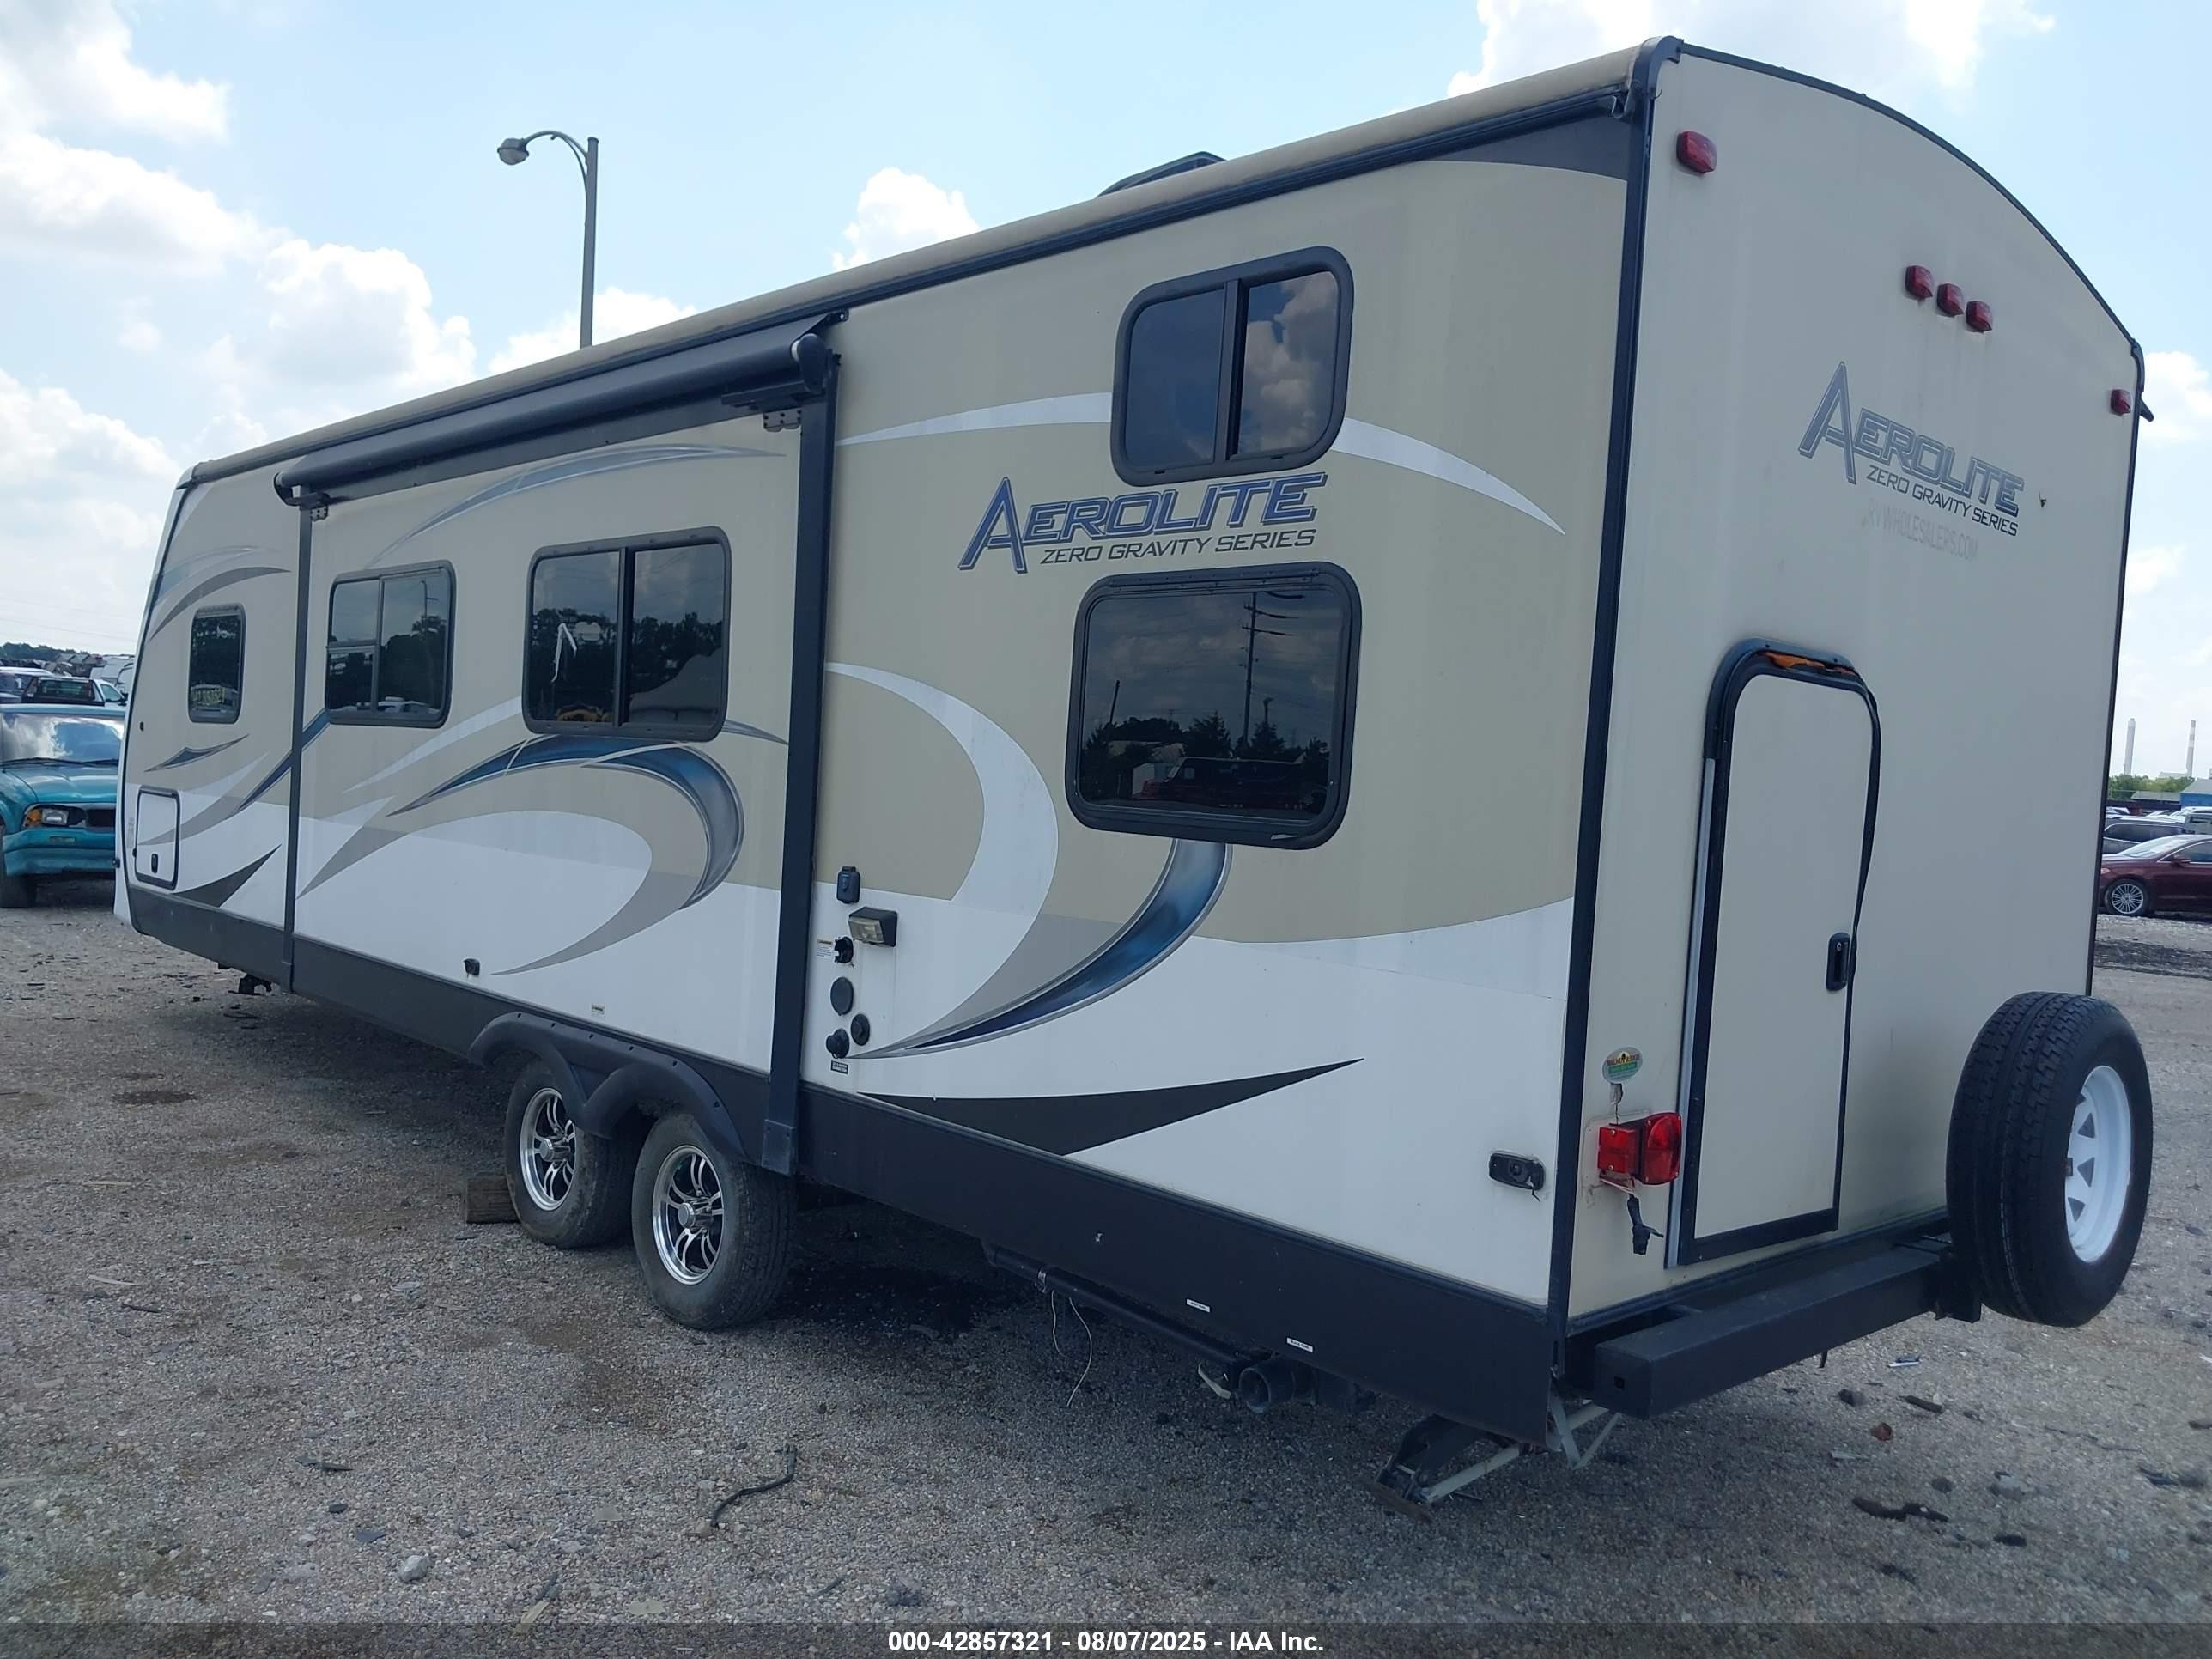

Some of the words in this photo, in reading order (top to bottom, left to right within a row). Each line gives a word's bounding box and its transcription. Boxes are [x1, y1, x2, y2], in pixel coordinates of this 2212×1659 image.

[1798, 361, 2025, 517] AEROLITE
[958, 471, 1328, 574] AEROLITE
[1866, 464, 1910, 495] ZERO
[1911, 483, 1972, 518] GRAVITY
[1972, 507, 2019, 537] SERIES
[1040, 545, 1103, 565] ZERO
[1108, 537, 1213, 560] GRAVITY
[1214, 528, 1317, 552] SERIES
